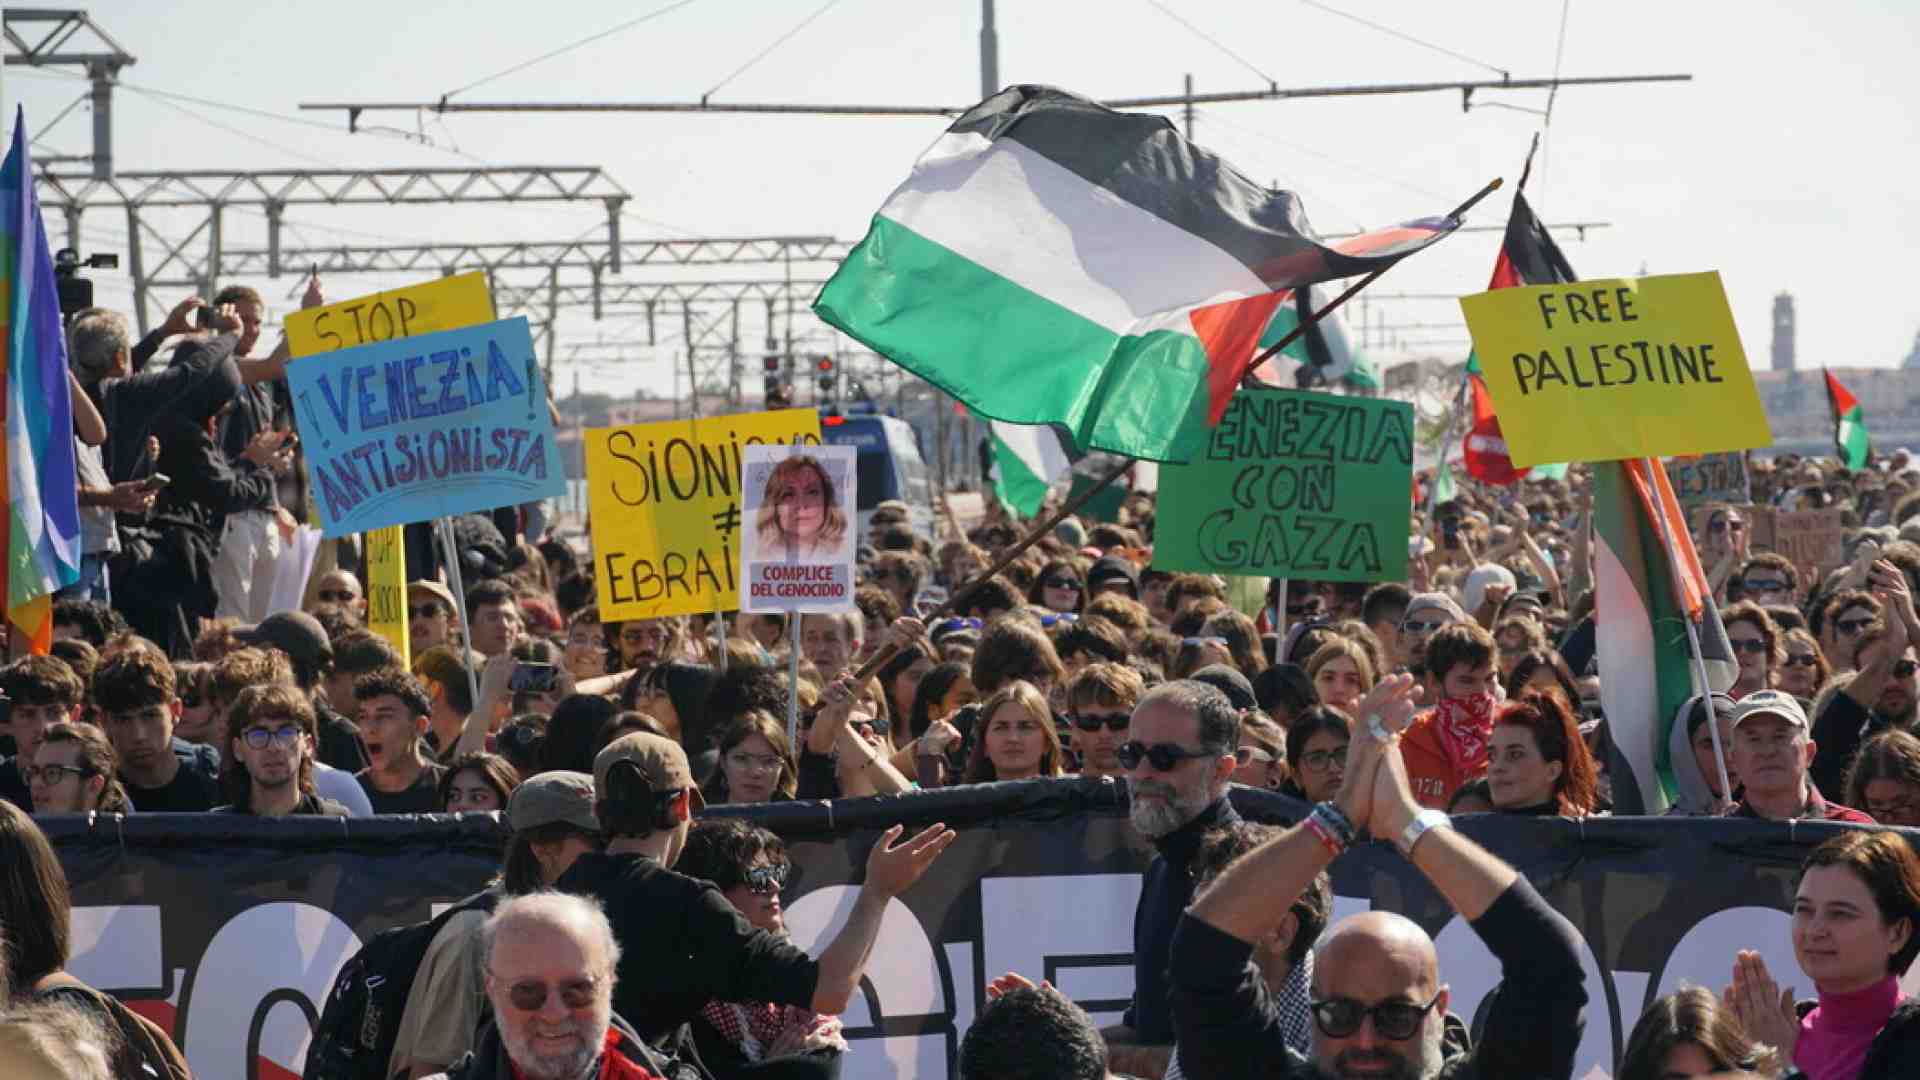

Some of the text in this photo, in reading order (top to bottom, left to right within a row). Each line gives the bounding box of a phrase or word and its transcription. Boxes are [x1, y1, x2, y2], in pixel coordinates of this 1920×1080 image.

[314, 297, 417, 348] STOP
[1538, 287, 1638, 329] FREE
[1512, 341, 1723, 394] PALESTINE
[1207, 394, 1414, 465] ENEZIA
[1233, 465, 1336, 512] CON
[1197, 509, 1381, 572] GAZA
[605, 535, 735, 604] EBRAi
[751, 583, 844, 597] DEL GENOCIDIO
[763, 565, 833, 581] COMPLICE
